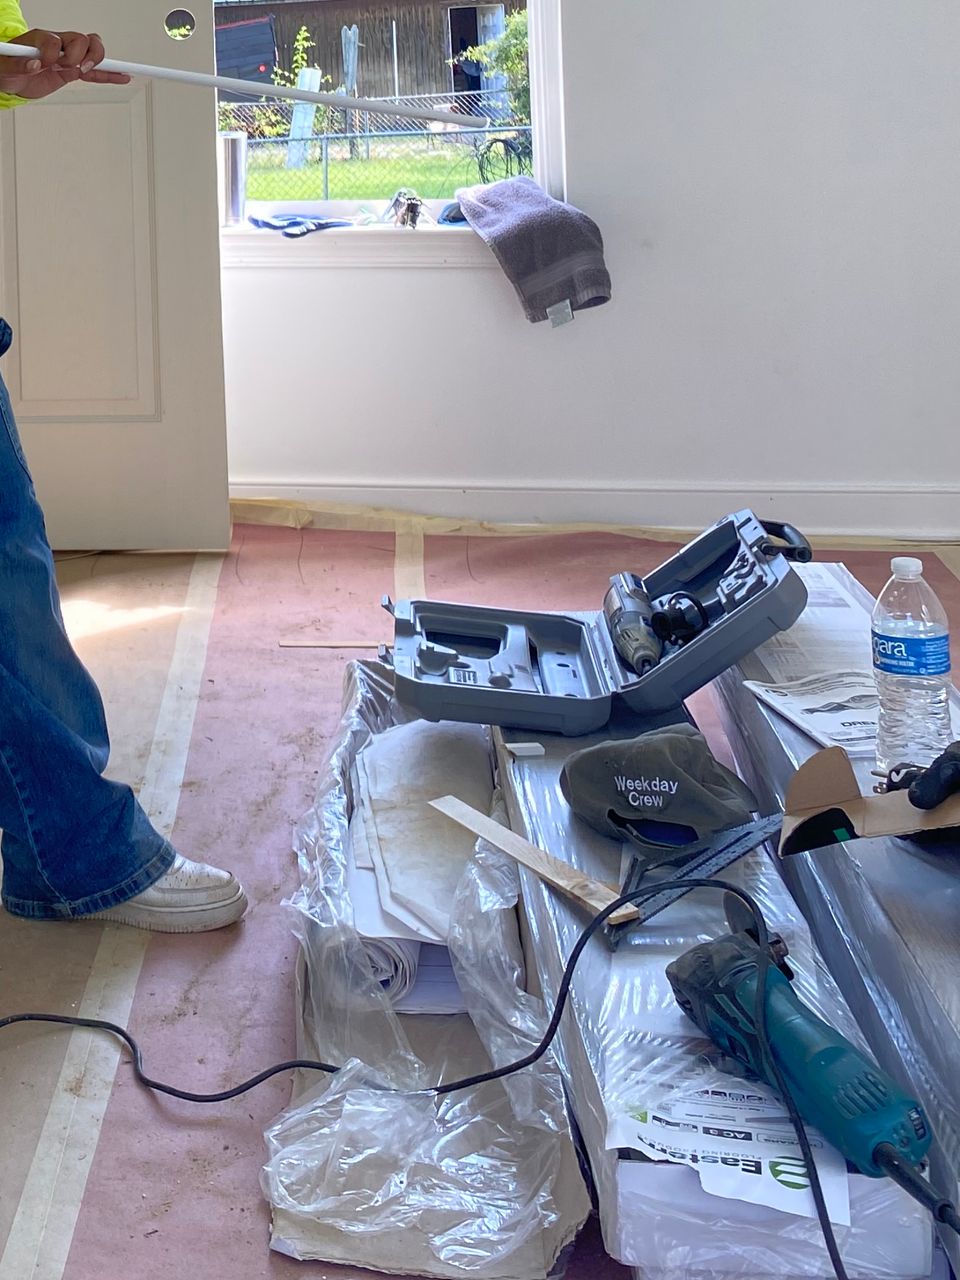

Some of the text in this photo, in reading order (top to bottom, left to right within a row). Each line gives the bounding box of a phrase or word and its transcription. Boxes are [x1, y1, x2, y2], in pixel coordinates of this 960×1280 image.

[614, 776, 678, 794] Weekday
[628, 791, 663, 807] Crew
[722, 1130, 746, 1139] AC
